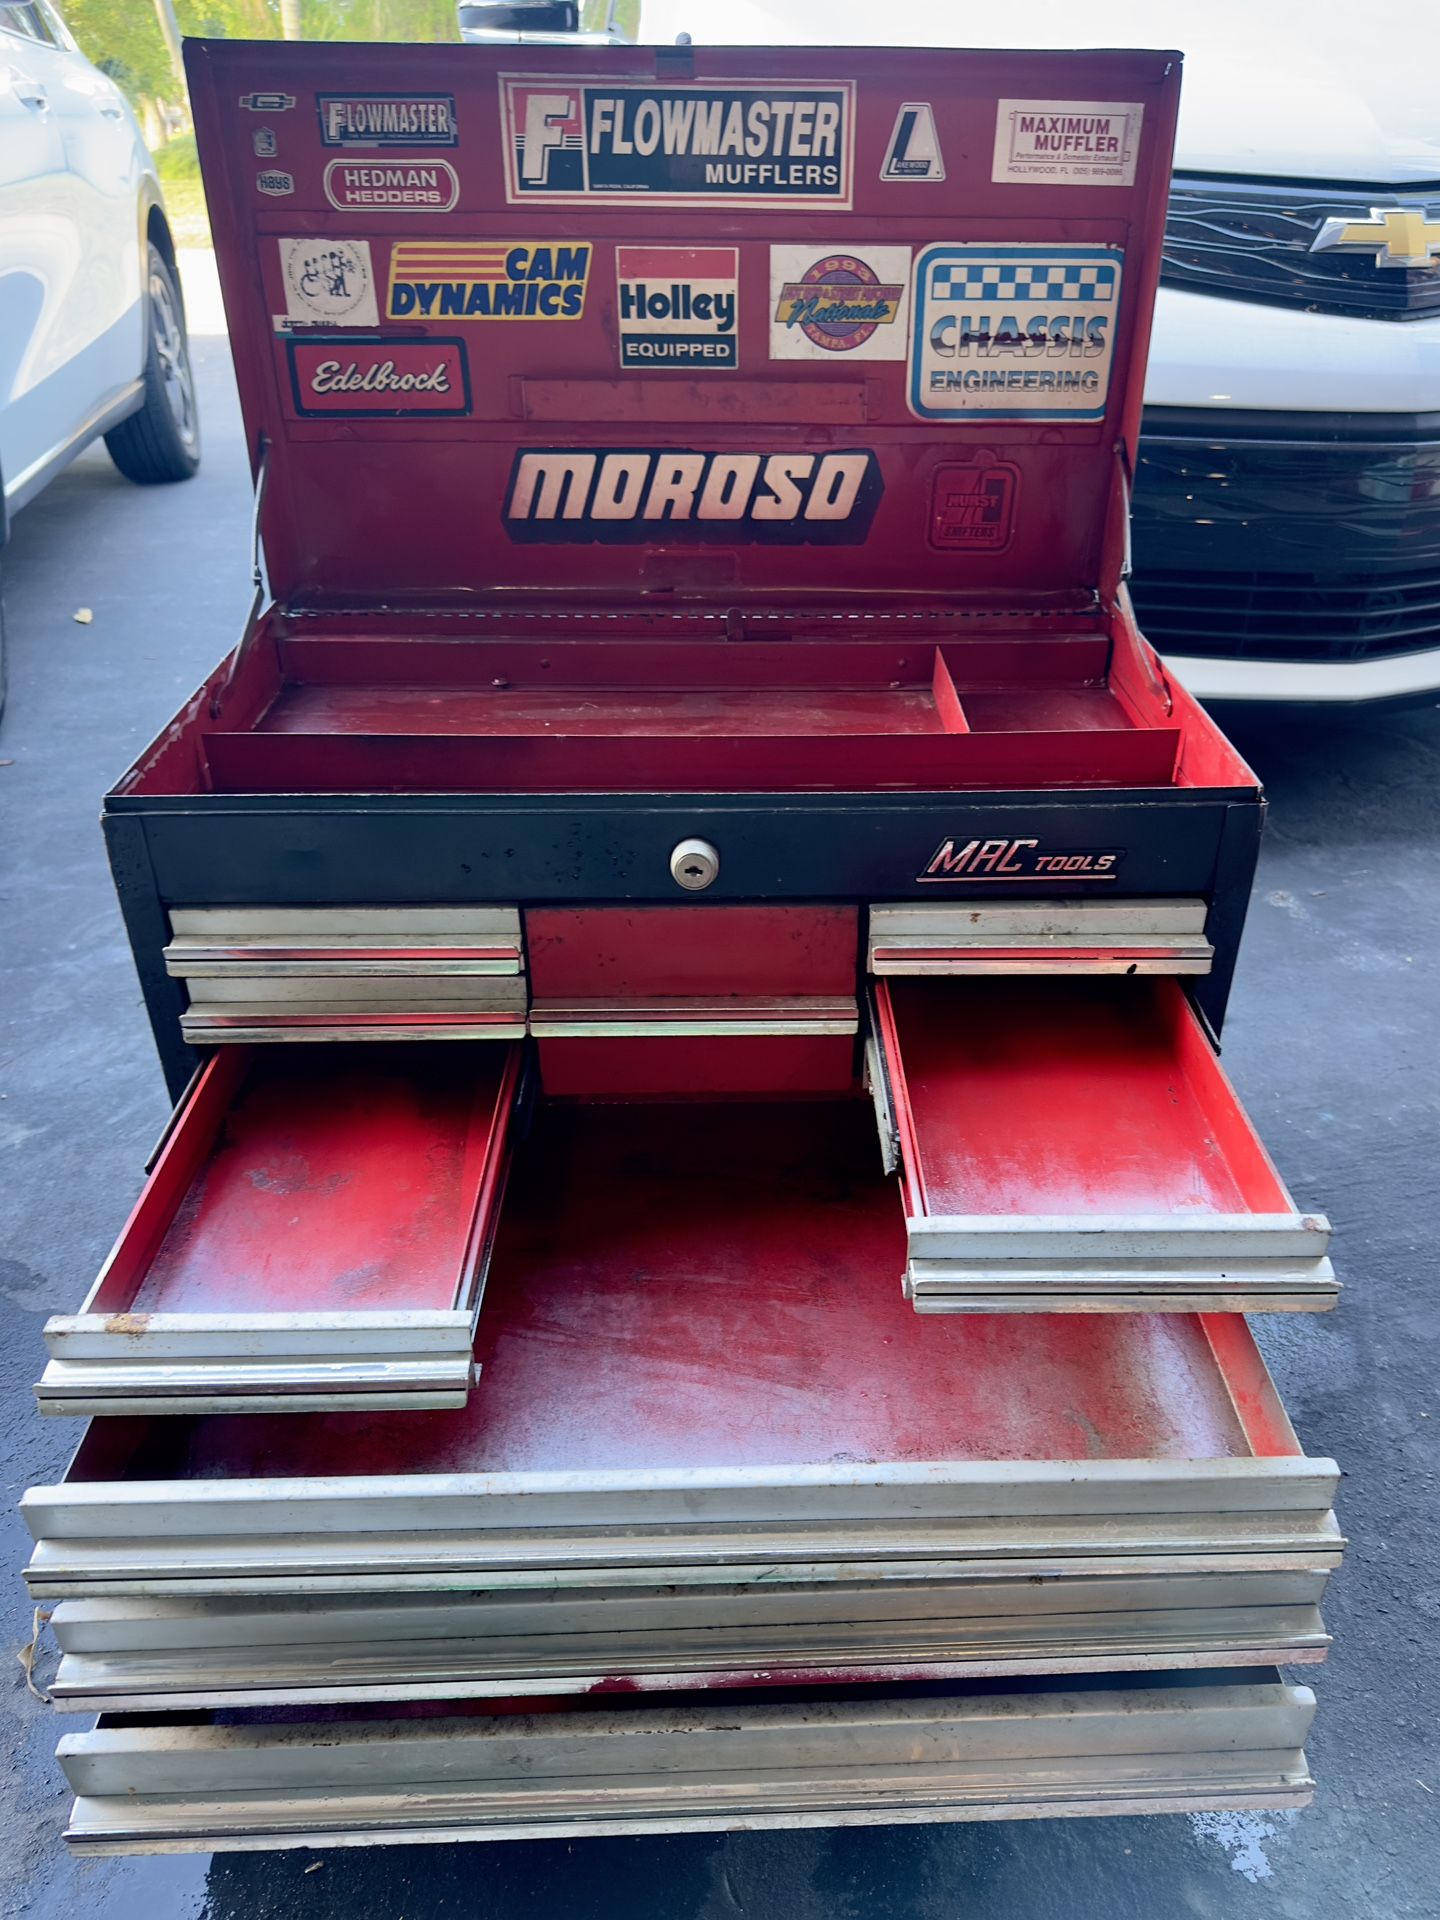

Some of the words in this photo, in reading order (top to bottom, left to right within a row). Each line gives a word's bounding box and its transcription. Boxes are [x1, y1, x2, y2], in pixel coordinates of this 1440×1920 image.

[328, 103, 449, 139] FLOWMASTER
[590, 99, 840, 157] FLOWMASTER
[1020, 116, 1110, 135] MAXIMUM
[1034, 135, 1119, 152] MUFFLER
[343, 170, 437, 187] HEDMAN
[705, 164, 839, 185] MUFFLERS
[346, 191, 441, 203] HEDDERS
[506, 247, 589, 281] CAM
[811, 260, 871, 281] 1993
[391, 283, 583, 316] DYNAMICS
[620, 284, 736, 332] Holley
[786, 294, 890, 329] Nationals
[626, 342, 731, 358] EQUIPPED
[930, 315, 1108, 358] CHASSIS
[312, 361, 449, 392] Edelbrock
[930, 370, 1099, 393] ENGINEERING
[508, 453, 870, 520] MOROSO
[927, 839, 1039, 873] MAC
[1035, 855, 1116, 871] TOOLS
